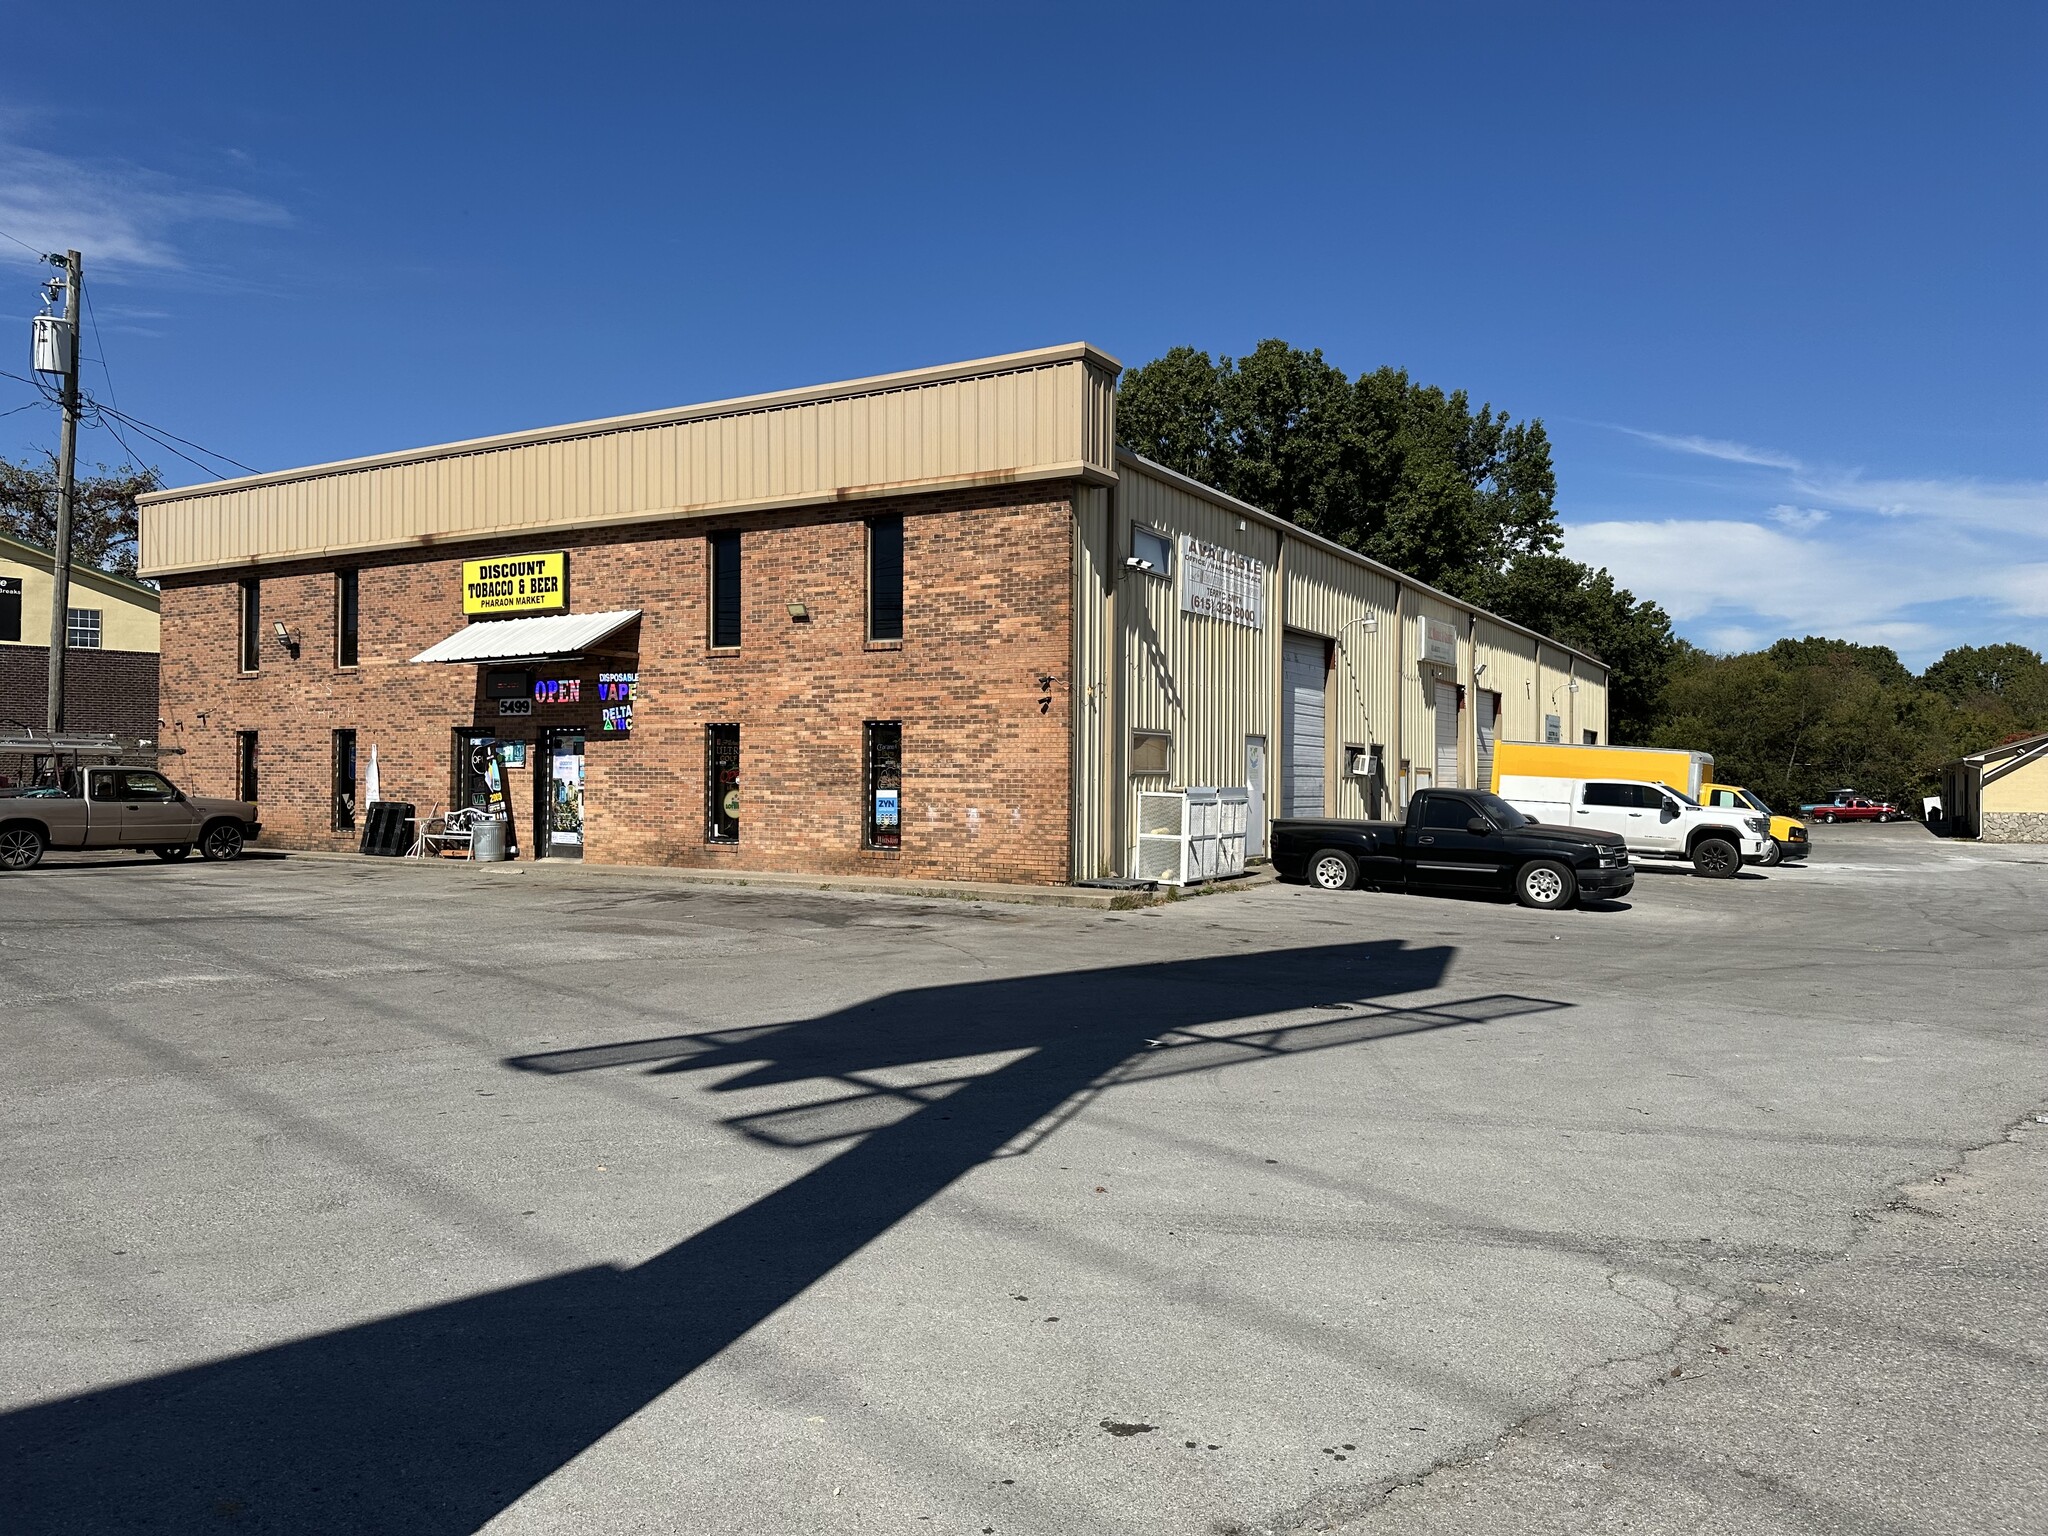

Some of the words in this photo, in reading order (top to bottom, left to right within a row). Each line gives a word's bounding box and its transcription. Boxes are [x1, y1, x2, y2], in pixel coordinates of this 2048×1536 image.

[1184, 554, 1206, 566] OFFICE
[1189, 541, 1261, 574] AVAILABLE
[479, 560, 546, 580] DISCOUNT
[468, 580, 514, 599] TOBACCO
[518, 579, 525, 594] &
[530, 576, 558, 594] BEER
[481, 597, 514, 608] PHARAON
[515, 595, 545, 606] MARKET
[1191, 595, 1214, 612] (615)
[1216, 601, 1255, 622] 329-8000
[599, 673, 639, 682] DISPOSABLE
[534, 679, 581, 703] OPEN
[598, 683, 638, 701] VAPE
[500, 700, 530, 714] 5499
[602, 704, 633, 721] DELTA
[472, 755, 484, 764] OP
[473, 794, 485, 804] VA
[878, 800, 895, 808] ZYN
